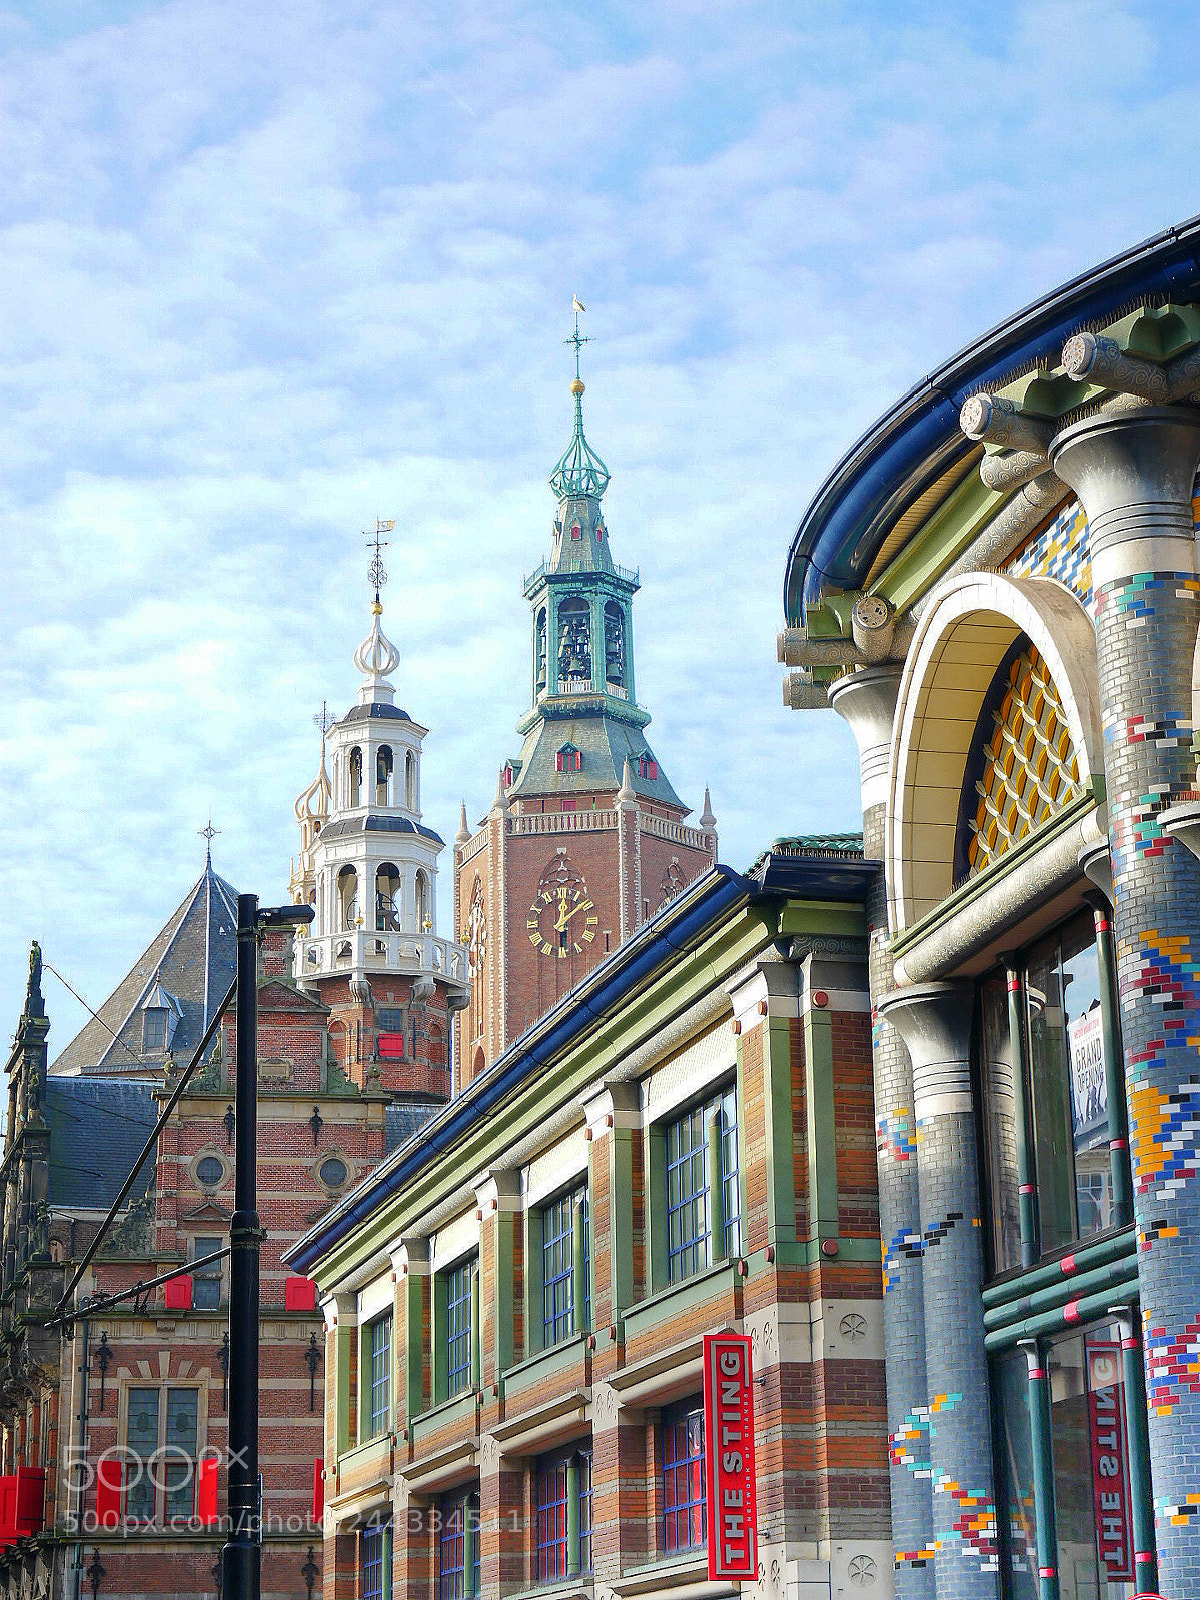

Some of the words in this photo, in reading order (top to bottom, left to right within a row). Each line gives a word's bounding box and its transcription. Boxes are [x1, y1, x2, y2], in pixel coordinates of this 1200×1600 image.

[1075, 1037, 1102, 1072] GRAND
[1077, 1062, 1104, 1094] OPENING
[720, 1352, 743, 1473] STING
[724, 1488, 745, 1564] THE
